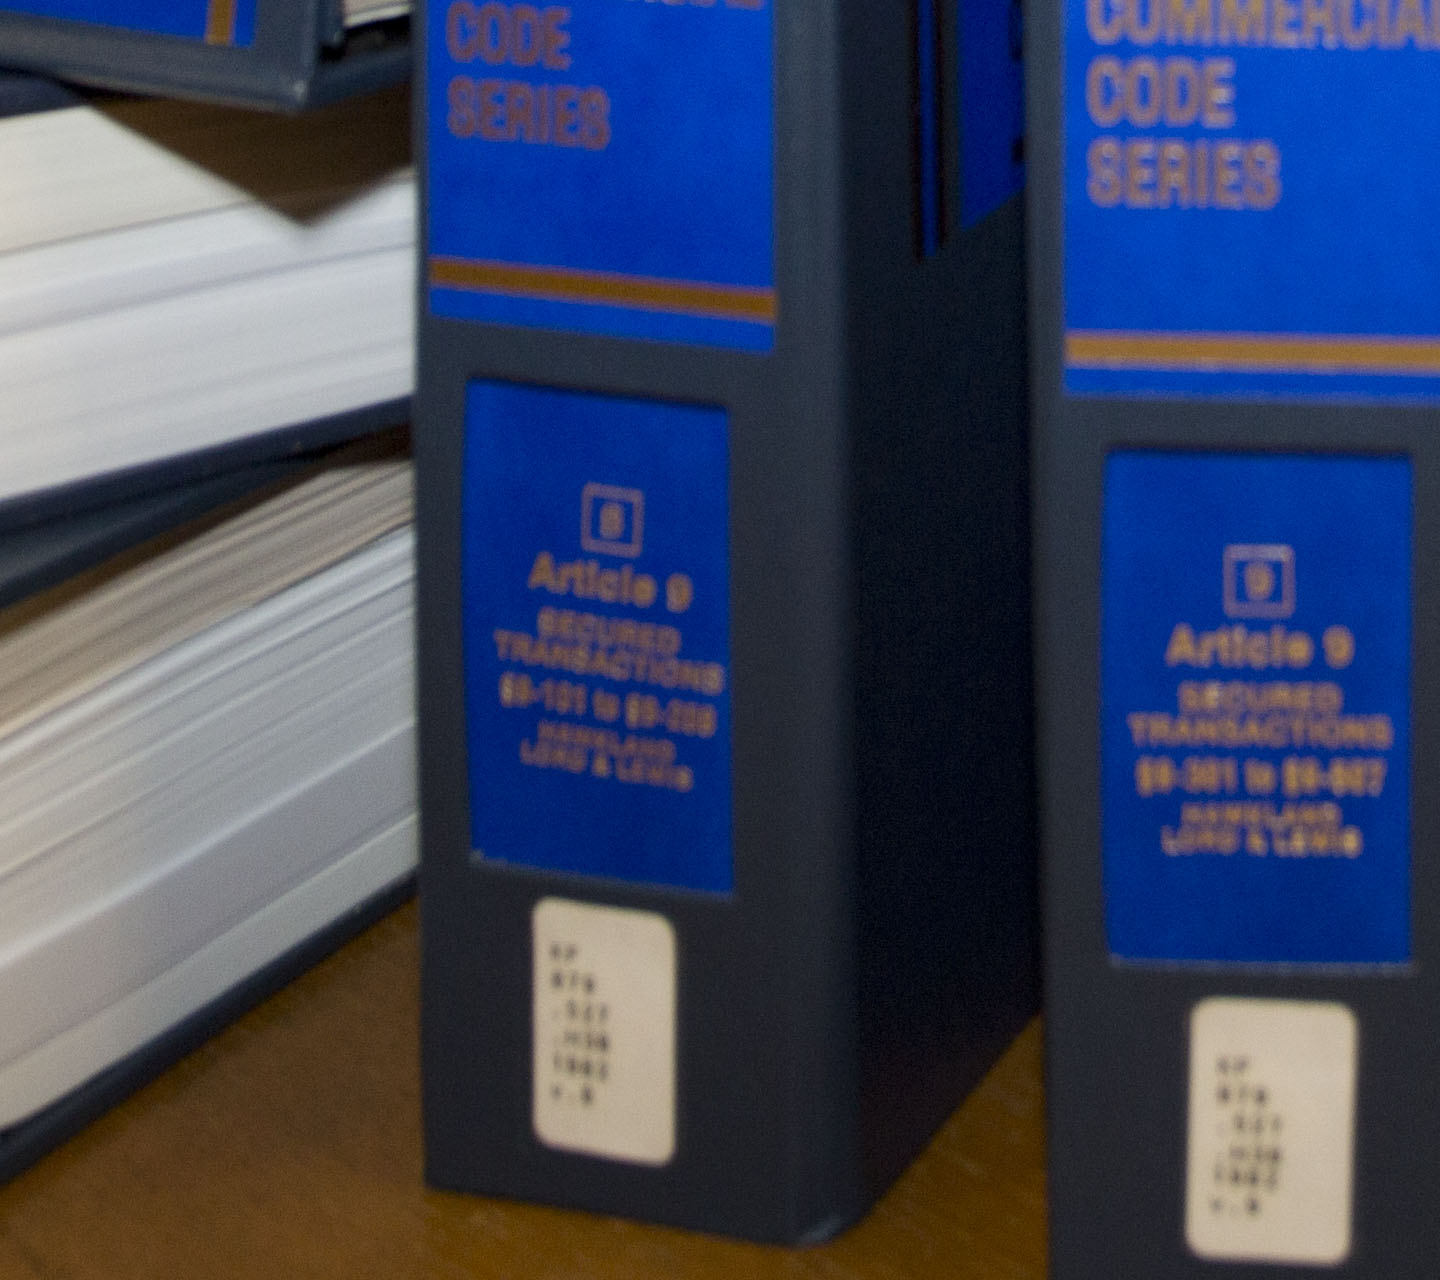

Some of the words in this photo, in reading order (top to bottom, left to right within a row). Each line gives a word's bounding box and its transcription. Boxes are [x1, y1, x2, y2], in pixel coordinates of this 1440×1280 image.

[446, 0, 572, 70] CODE
[447, 75, 611, 152] SERIES
[1086, 55, 1236, 129] CODE
[1086, 137, 1282, 211] SERIES
[529, 551, 658, 608] Article
[493, 629, 724, 695] TRANSACTIONS
[1165, 623, 1314, 669] Article
[1128, 712, 1393, 750] TRANSACTIONS
